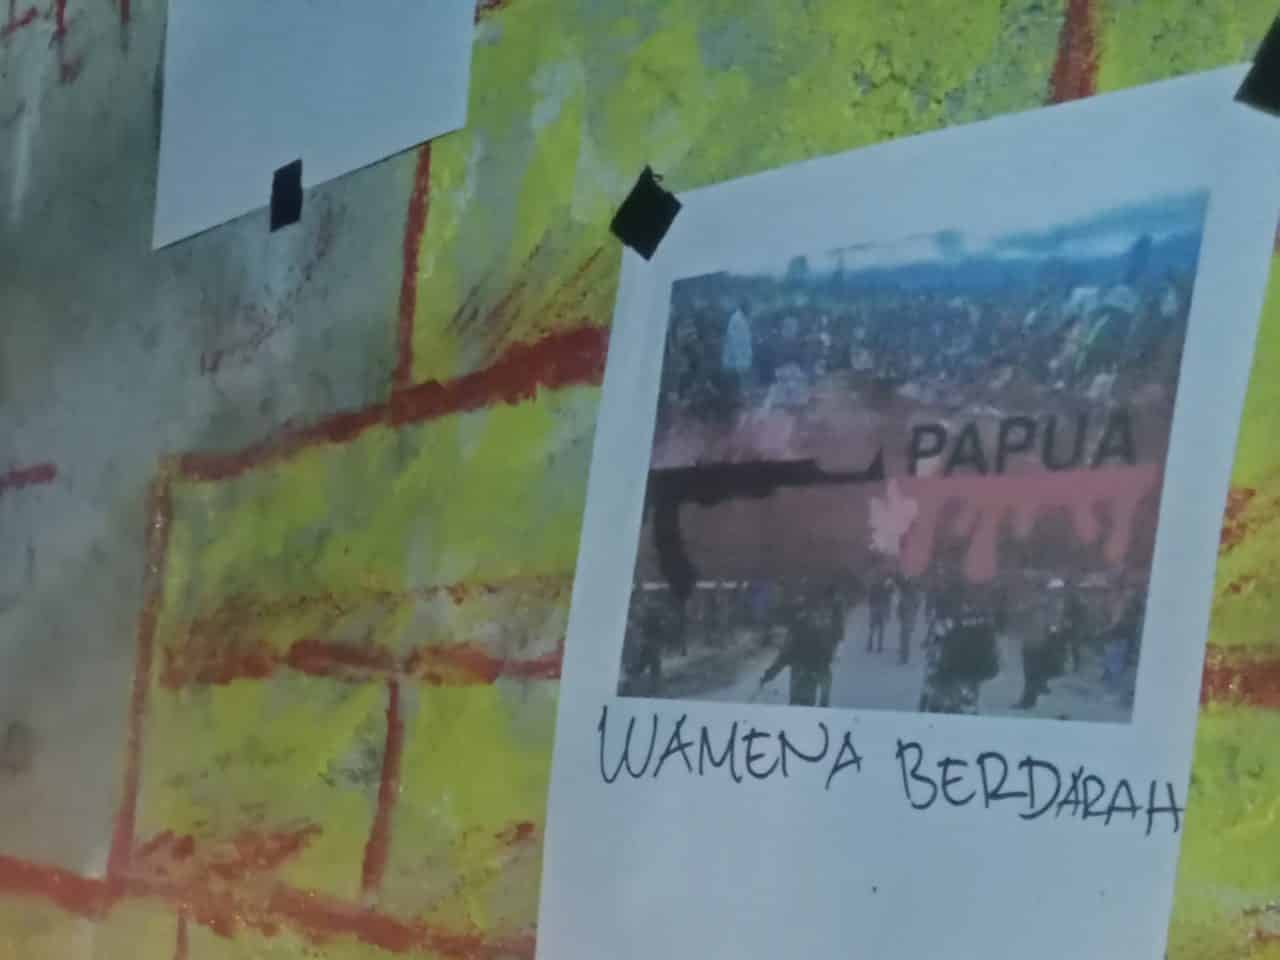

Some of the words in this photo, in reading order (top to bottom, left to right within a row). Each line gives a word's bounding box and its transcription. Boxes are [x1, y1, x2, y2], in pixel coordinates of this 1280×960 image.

[906, 407, 1137, 477] PAPUA
[598, 704, 863, 790] WAMENA
[895, 738, 1185, 836] BERDARAH
